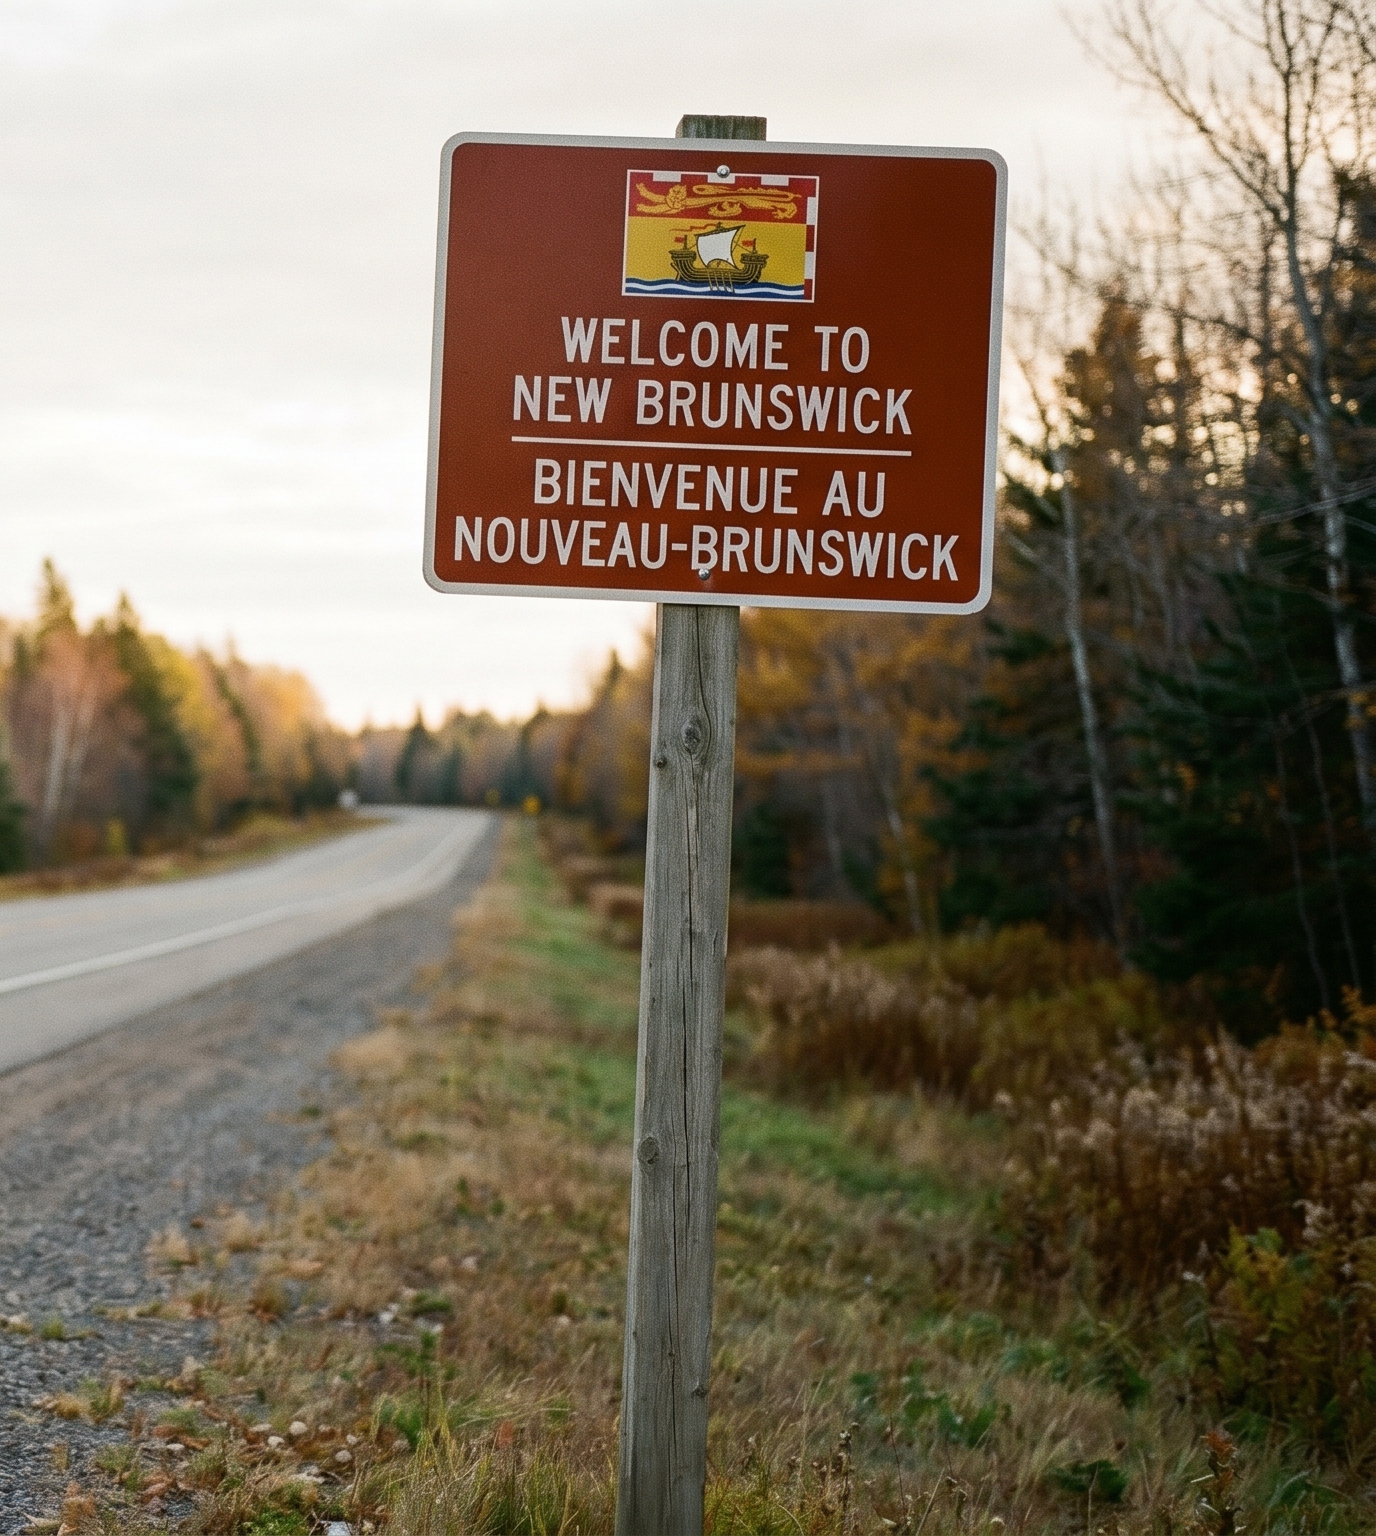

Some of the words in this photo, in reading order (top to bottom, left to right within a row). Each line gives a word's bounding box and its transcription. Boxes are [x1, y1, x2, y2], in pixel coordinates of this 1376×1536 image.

[561, 317, 788, 370] WELCOME
[815, 326, 869, 373] TO
[514, 375, 612, 423] NEW
[637, 380, 912, 434] BRUNSWICK
[534, 459, 798, 514] BIENVENUE
[823, 471, 885, 517] AU
[455, 516, 958, 580] NOUVEAU-BRUNSWICK
